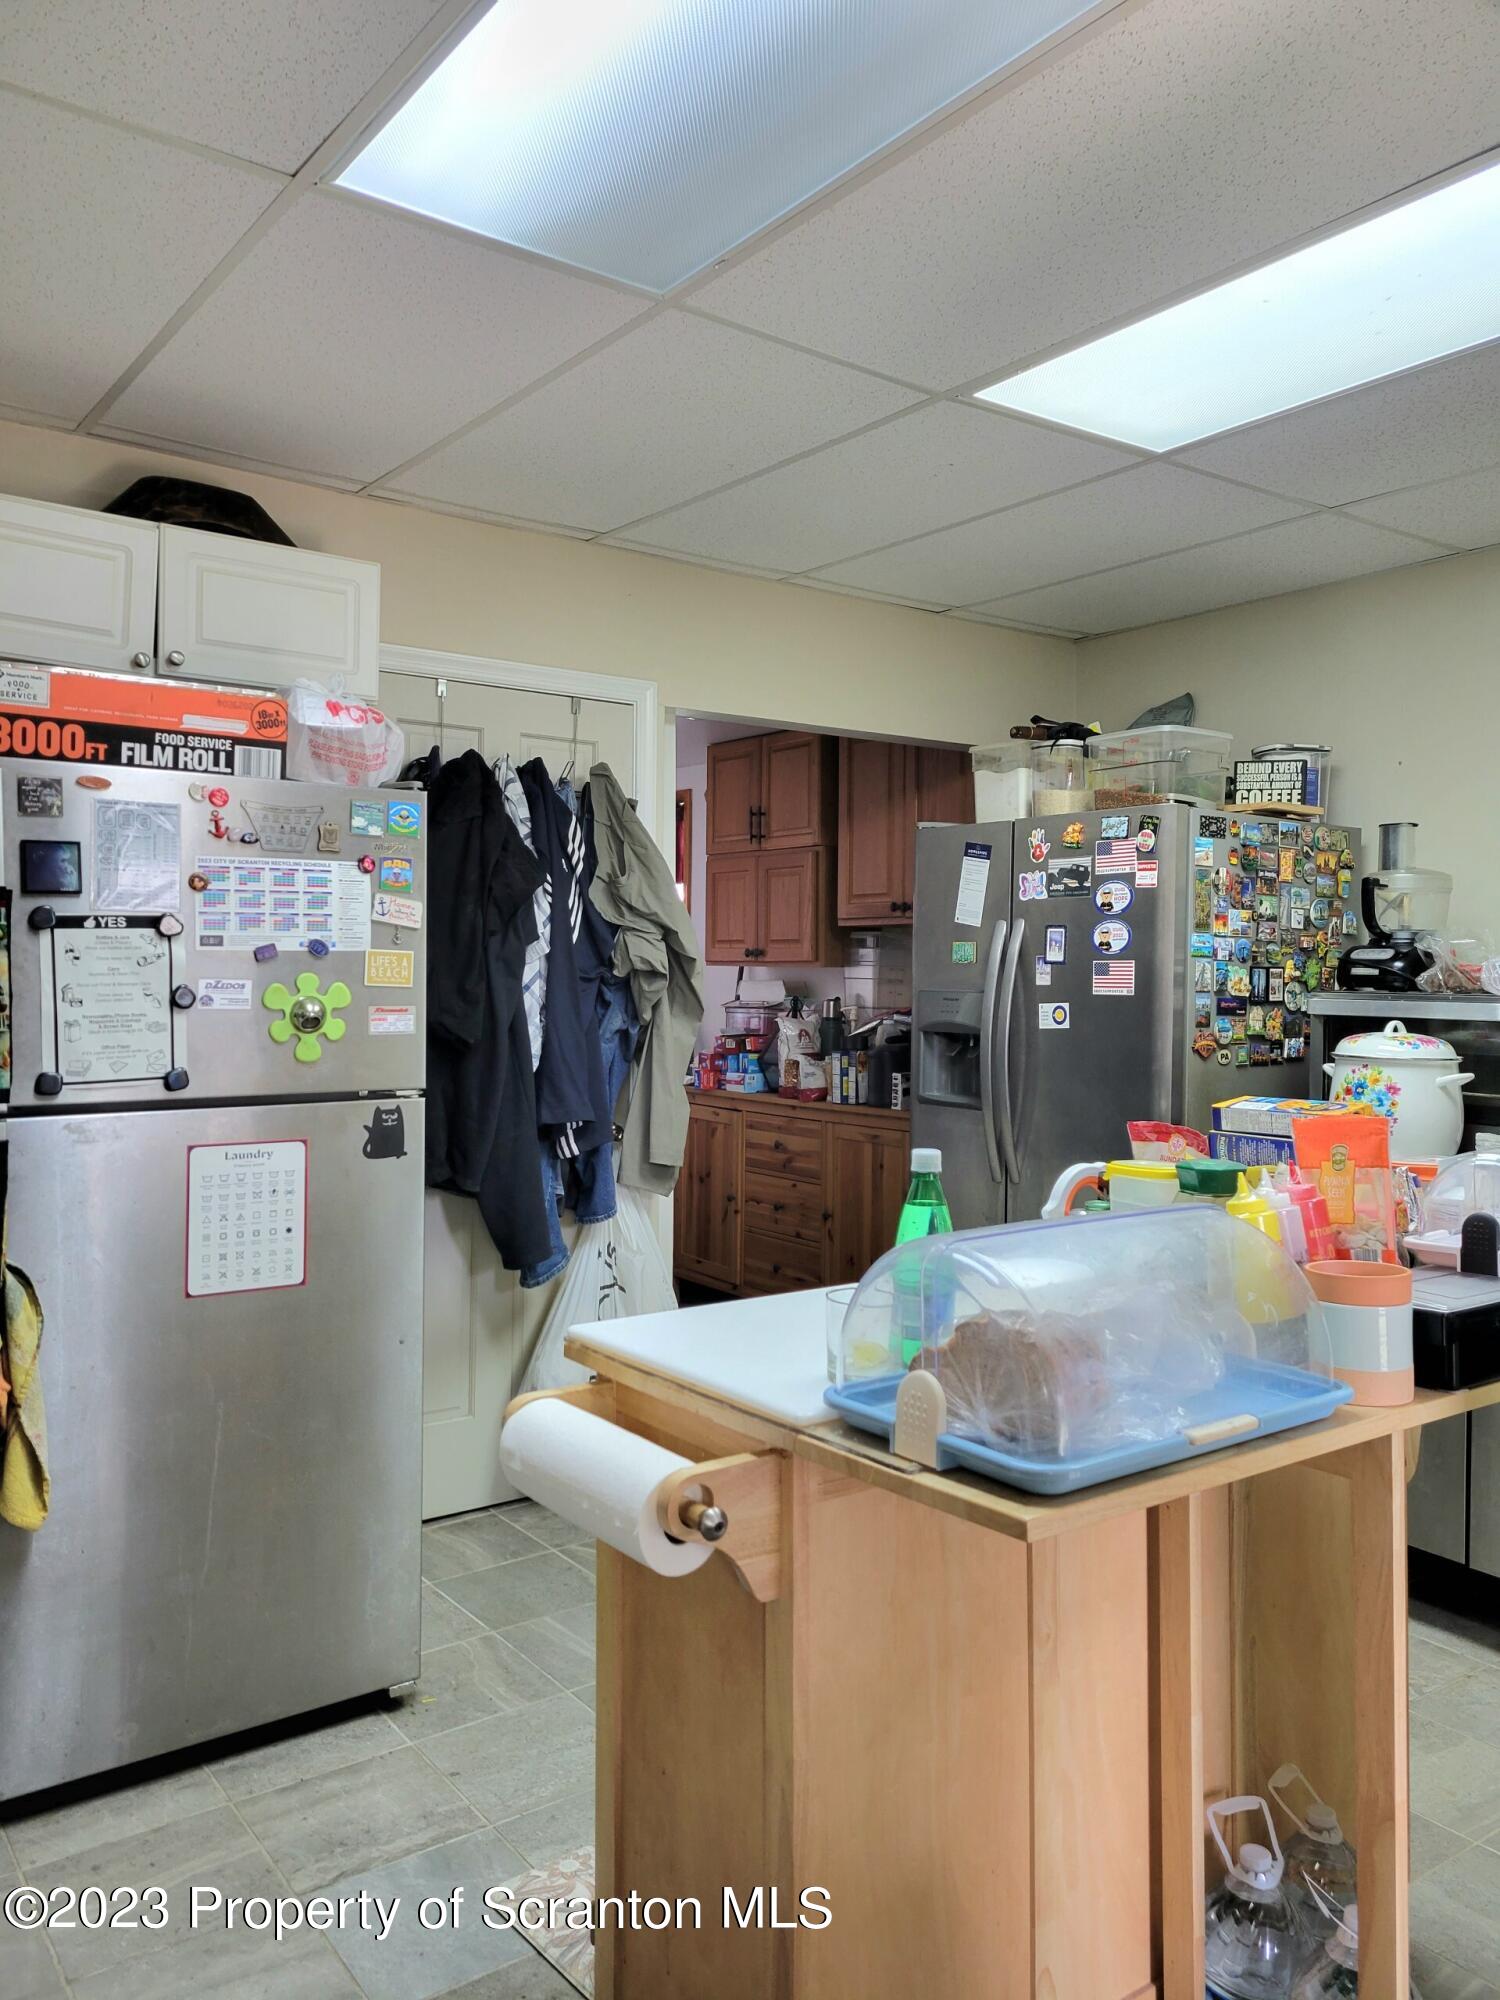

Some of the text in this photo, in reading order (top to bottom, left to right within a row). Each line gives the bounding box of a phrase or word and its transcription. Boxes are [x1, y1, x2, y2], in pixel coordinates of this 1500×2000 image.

[155, 732, 232, 751] FOOD SERVICE
[121, 741, 232, 774] FILM ROLL
[1236, 761, 1303, 774] BEHIND EVERY
[1236, 773, 1303, 782] SUCCESSFUL PERSON IS A
[1236, 781, 1302, 790] SUBSTANTIAL AMOUNT OF
[1235, 789, 1302, 805] COFFEE
[1049, 883, 1065, 891] Jeep
[97, 916, 128, 928] YES
[371, 955, 409, 967] LIFE'S A
[370, 967, 409, 978] BEACH
[224, 1149, 274, 1161] Laundry
